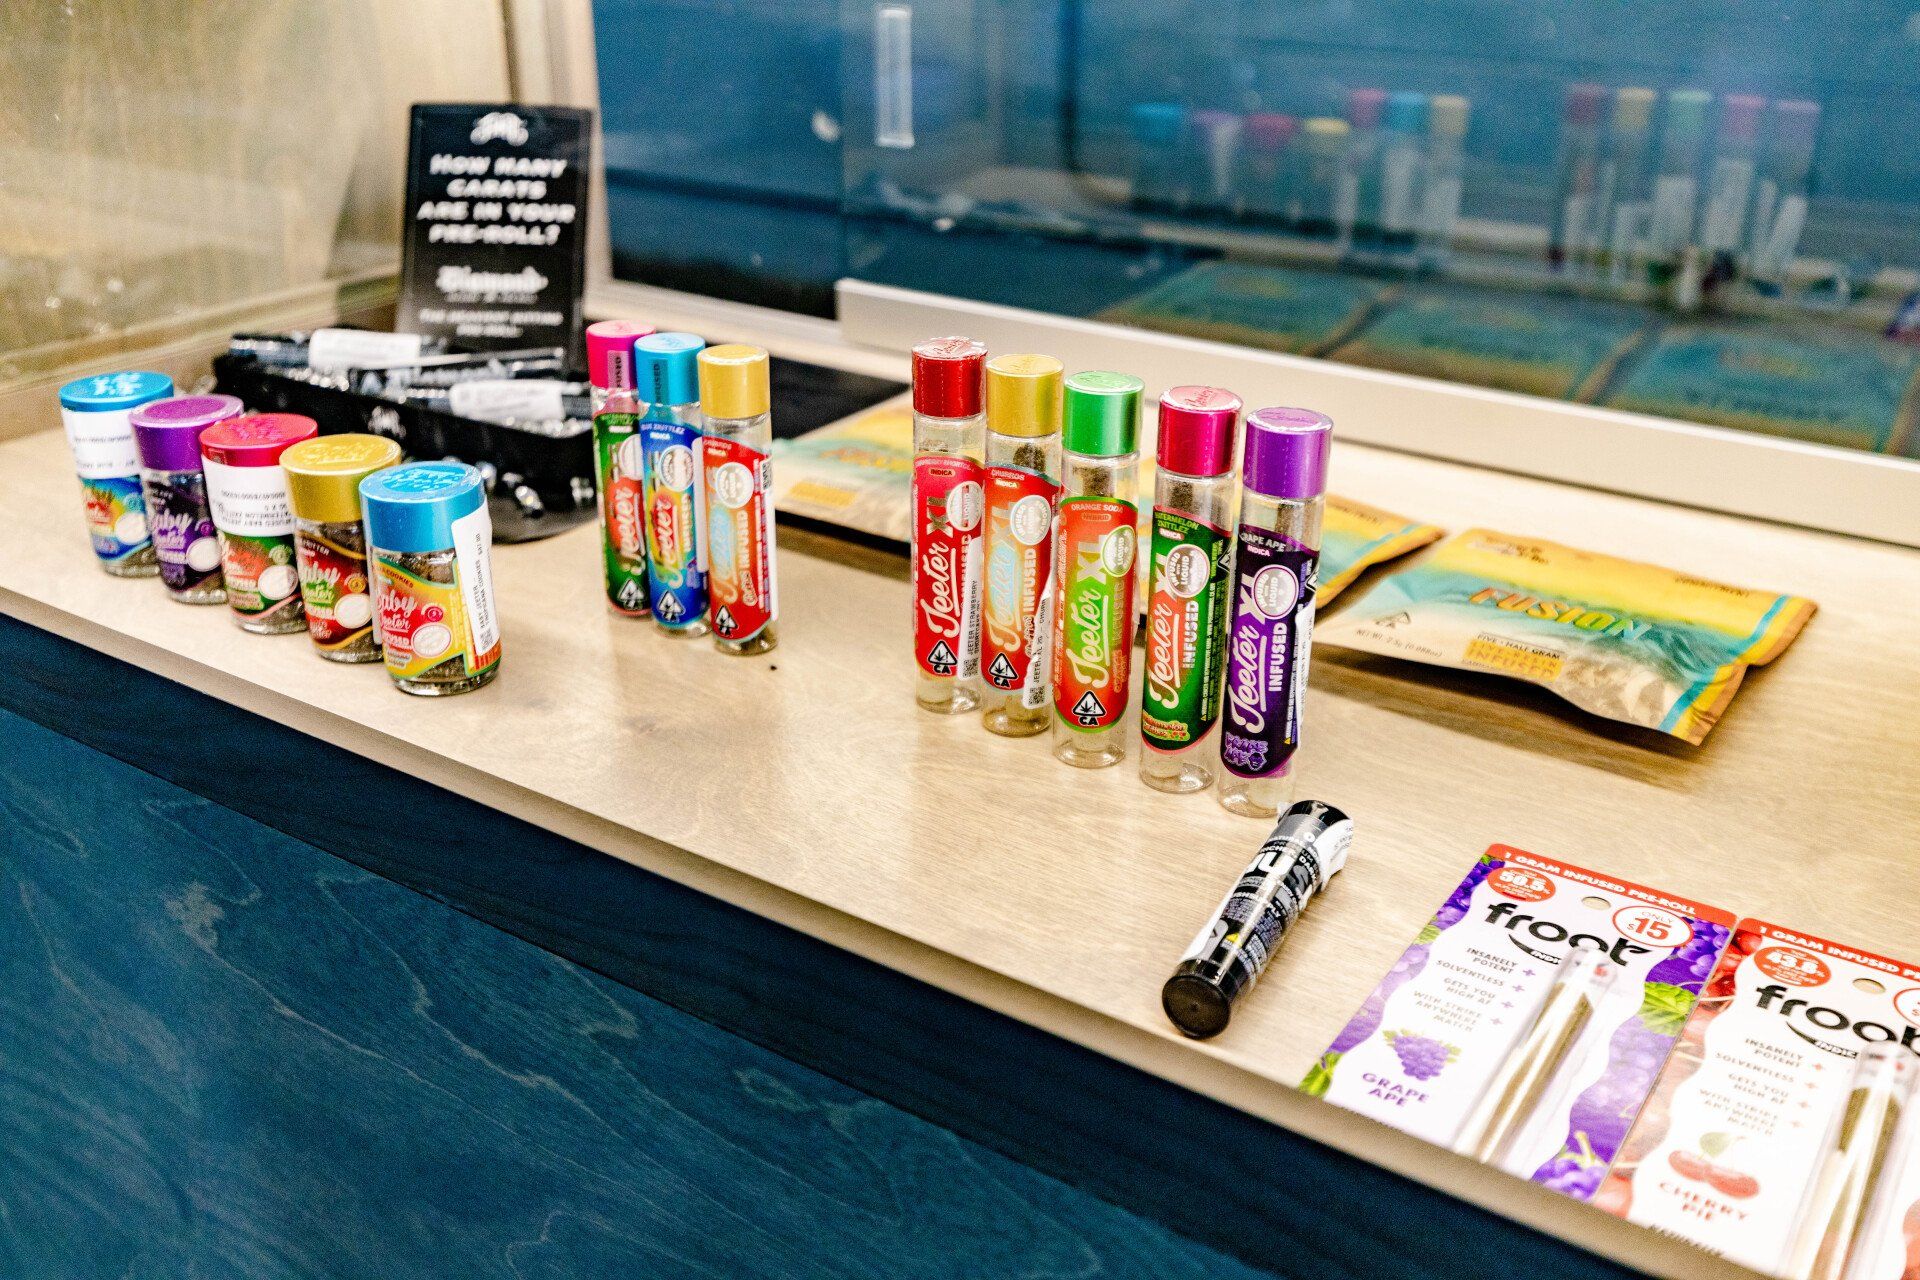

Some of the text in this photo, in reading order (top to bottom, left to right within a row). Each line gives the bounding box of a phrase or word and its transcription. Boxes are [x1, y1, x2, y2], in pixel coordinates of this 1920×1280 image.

[430, 154, 567, 178] HOW MANY
[417, 201, 576, 223] ARE IN YOUR
[930, 468, 953, 476] INDICA
[1071, 503, 1102, 511] ORANGE
[1247, 544, 1271, 557] INDICA
[1266, 538, 1287, 552] APE
[475, 559, 484, 587] COOKIES
[1023, 548, 1037, 612] INFUSED
[1169, 552, 1181, 586] INFUSED
[1180, 555, 1190, 585] LIQUID
[920, 541, 961, 638] Jeeter
[985, 547, 1021, 652] Jeeter
[1257, 573, 1270, 607] INFUSED
[1269, 576, 1279, 607] LIQUID
[1468, 586, 1652, 641] FUSION
[1066, 588, 1110, 688] Jeeter
[1182, 600, 1199, 669] INFUSED
[1478, 633, 1497, 644] FIVE
[1148, 602, 1179, 709] Jeeter
[1268, 621, 1288, 692] INFUSED
[933, 664, 951, 675] CA
[993, 677, 1011, 687] CA
[1227, 624, 1265, 734] Jeeter
[1079, 716, 1099, 726] CA
[1515, 856, 1560, 874] GRAM
[1563, 869, 1625, 894] INFUSED
[1628, 887, 1697, 915] PRE-ROLL
[1626, 917, 1672, 940] $15
[1641, 911, 1674, 924] ONLY
[1484, 902, 1653, 967] froot
[1466, 947, 1518, 968] INSANELY
[1760, 926, 1900, 973] 1 GRAM INFUSED
[1436, 960, 1505, 987] SOLVENTLESS
[1472, 957, 1515, 974] POTENT
[1444, 978, 1496, 999] GETS YOU
[1446, 986, 1475, 1002] HIGH
[1415, 1000, 1477, 1026] ANYWHERE
[1445, 1002, 1482, 1018] STRIKE
[1745, 1038, 1803, 1060] INSANELY
[1754, 1049, 1801, 1067] POTENT
[1716, 1052, 1794, 1082] SOLVENTLESS
[1362, 1073, 1429, 1103] GRAPE
[1368, 1088, 1408, 1107] APE
[1764, 1085, 1789, 1098] YOU
[1659, 1182, 1747, 1221] CHERRY
